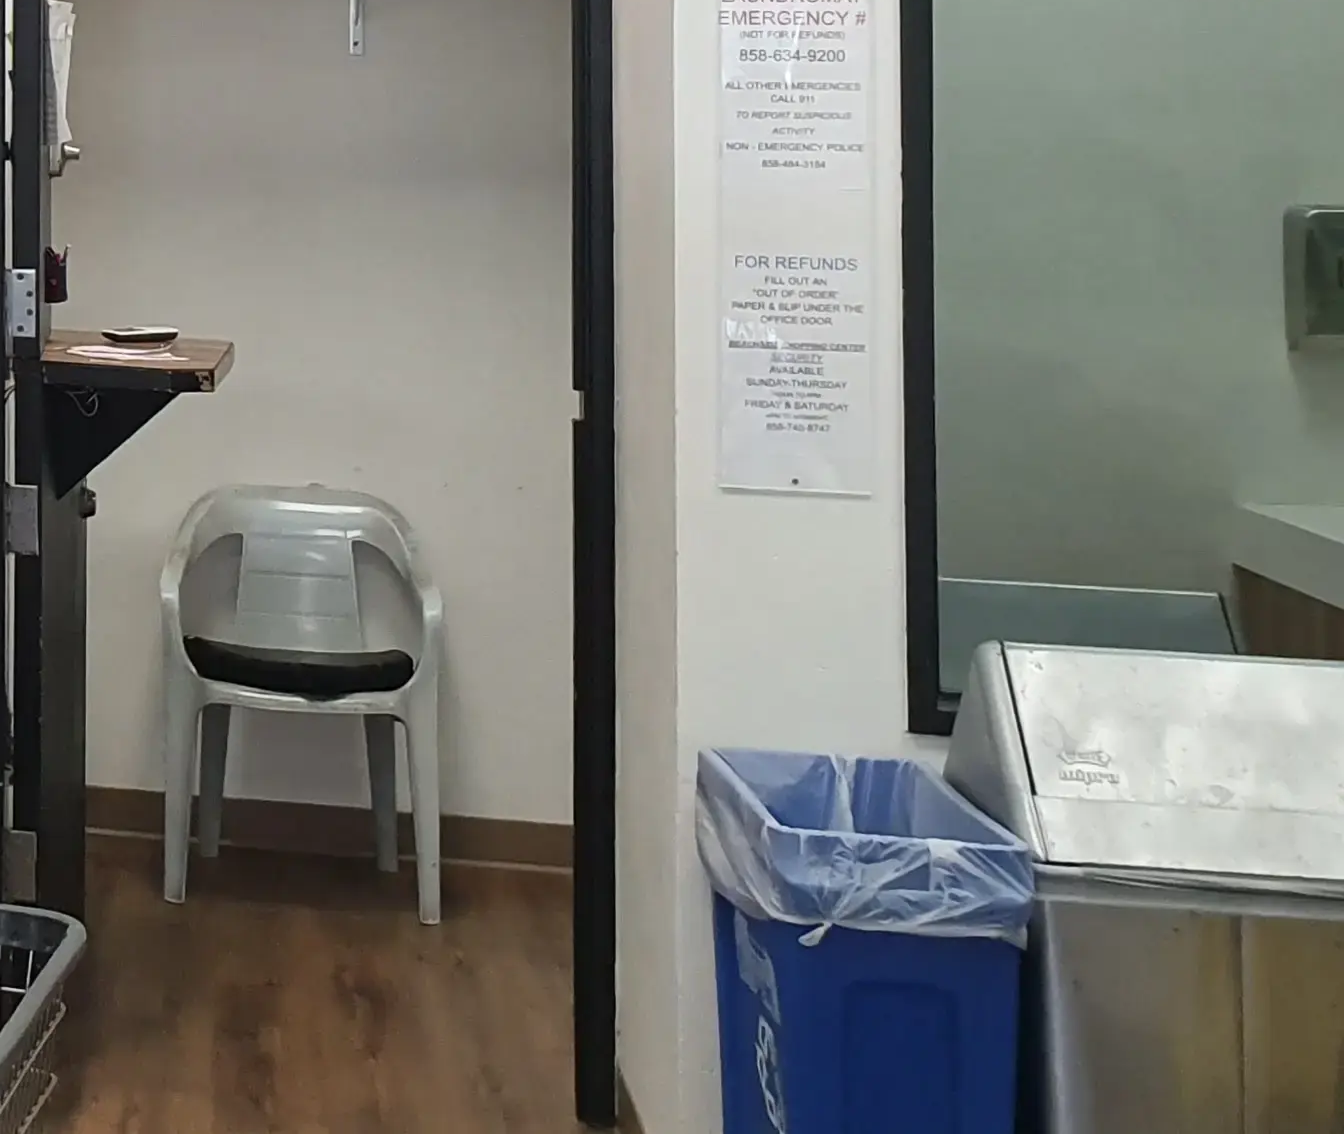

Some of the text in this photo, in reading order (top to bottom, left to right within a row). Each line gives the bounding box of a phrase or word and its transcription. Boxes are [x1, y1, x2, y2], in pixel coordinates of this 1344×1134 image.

[718, 10, 866, 26] EMERGENCY #
[767, 30, 790, 40] FOR
[739, 49, 846, 63] 858-634-9200
[725, 81, 743, 91] ALL
[745, 81, 782, 91] OTHER
[770, 94, 796, 104] CALL
[736, 111, 749, 120] TO
[751, 111, 791, 120] REPORT
[771, 127, 815, 136] ACTIVITY
[726, 142, 750, 151] NON
[757, 142, 823, 152] EMERGENCY
[826, 144, 864, 153] POLICE
[734, 255, 859, 271] FOR REFUNDS
[764, 276, 827, 286] FILL OUT AN
[781, 289, 794, 298] OF
[731, 301, 765, 311] PAPER
[768, 302, 776, 311] &
[803, 303, 841, 313] UNDER
[843, 304, 865, 314] THE
[760, 315, 833, 326] OFFICE DOOR
[769, 365, 825, 376] AVAILABLE
[744, 399, 782, 409] FRIDAY
[794, 401, 849, 412] SATURDAY
